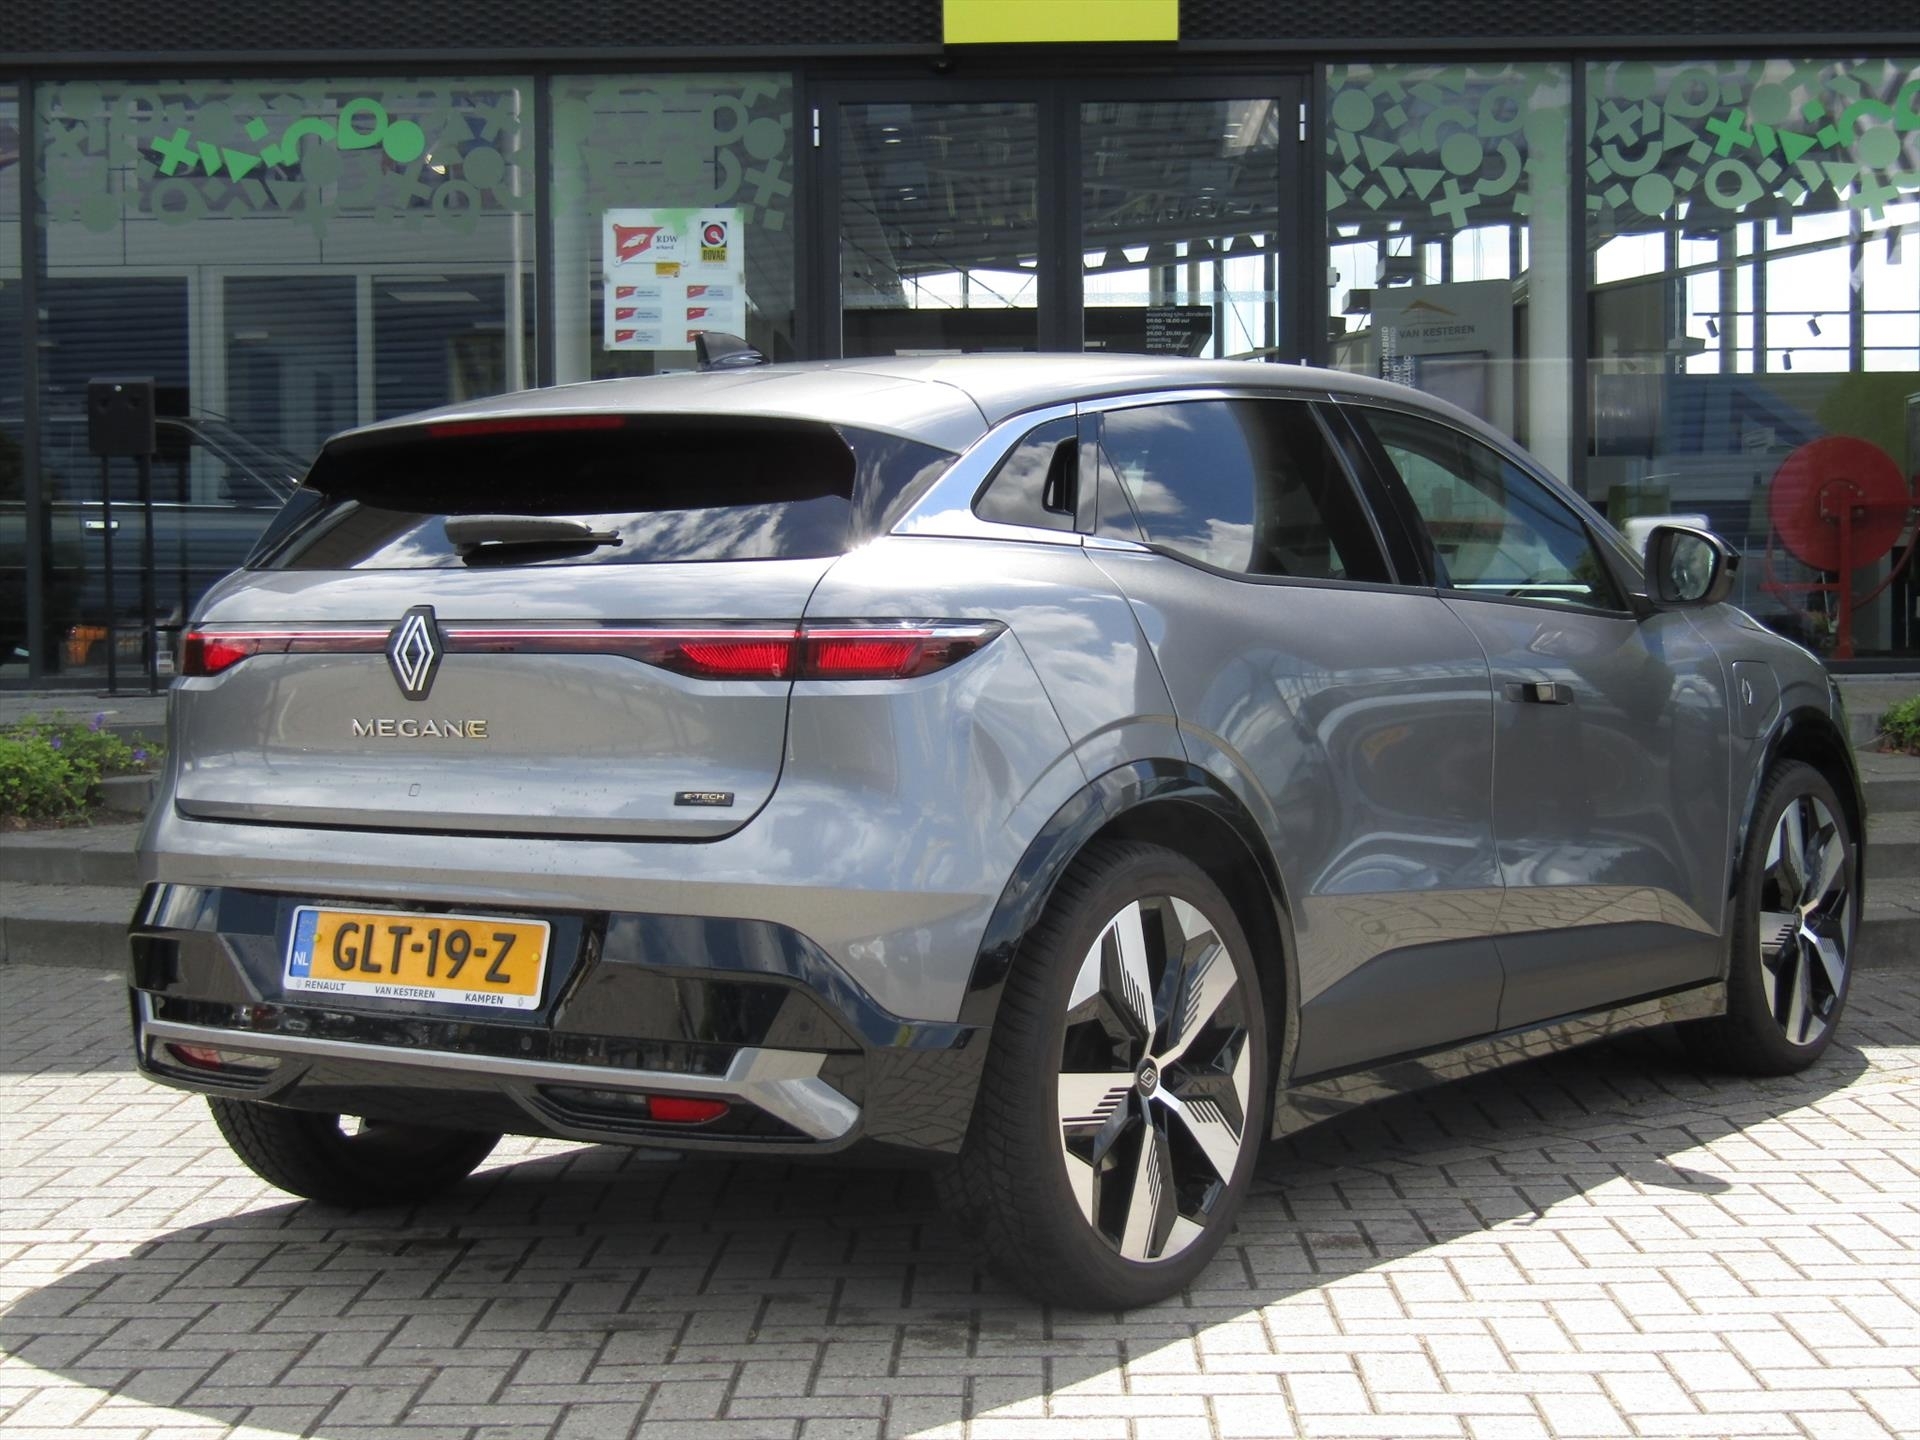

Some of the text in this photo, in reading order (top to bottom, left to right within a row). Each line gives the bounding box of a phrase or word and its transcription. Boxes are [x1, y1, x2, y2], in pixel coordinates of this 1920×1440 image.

[656, 235, 678, 243] RDW
[703, 249, 726, 261] BOVAG
[1400, 325, 1475, 338] VAN KESTEREN
[352, 718, 488, 738] MEGANE
[294, 951, 309, 966] NL
[332, 922, 517, 984] GLT-19-Z
[304, 980, 504, 1004] RENAULT VAN KESTEREN KAMPEN
